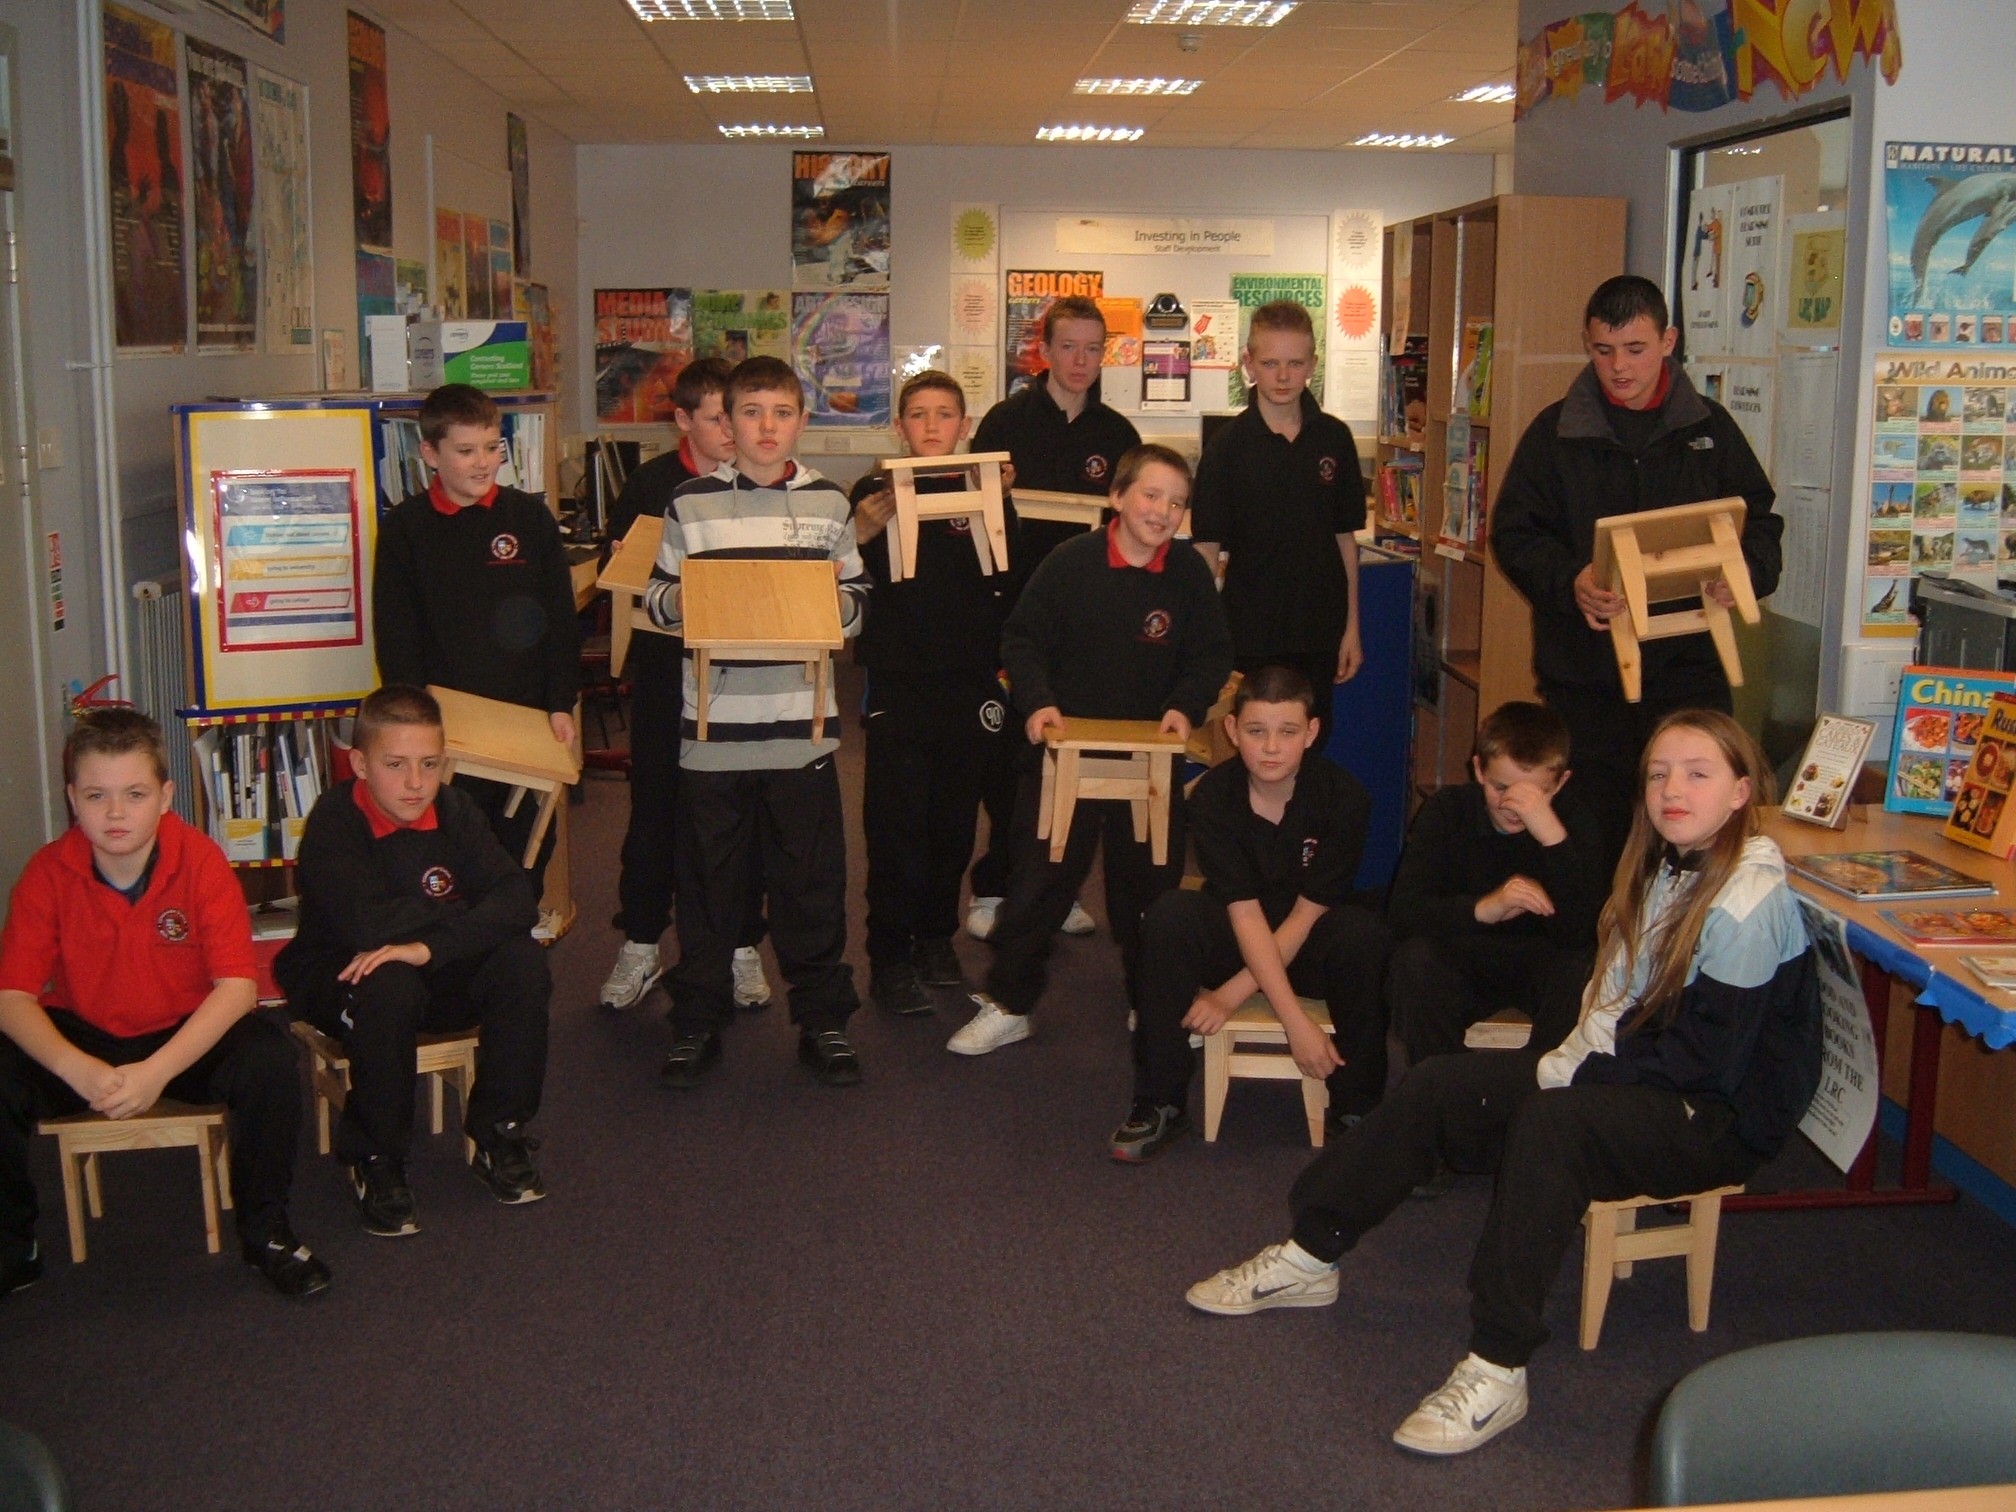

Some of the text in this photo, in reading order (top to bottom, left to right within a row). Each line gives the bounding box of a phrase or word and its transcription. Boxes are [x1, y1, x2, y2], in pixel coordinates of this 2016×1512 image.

[1900, 145, 2015, 164] NATURAL
[1134, 230, 1241, 243] Investing in People
[1154, 244, 1221, 255] Staff Development
[1007, 272, 1102, 297] GEOLOGY
[1234, 277, 1323, 289] ENVIRONMENTAL
[1888, 361, 1940, 379] Wild
[1844, 1063, 1864, 1092] THE
[1824, 1076, 1846, 1104] LRC
